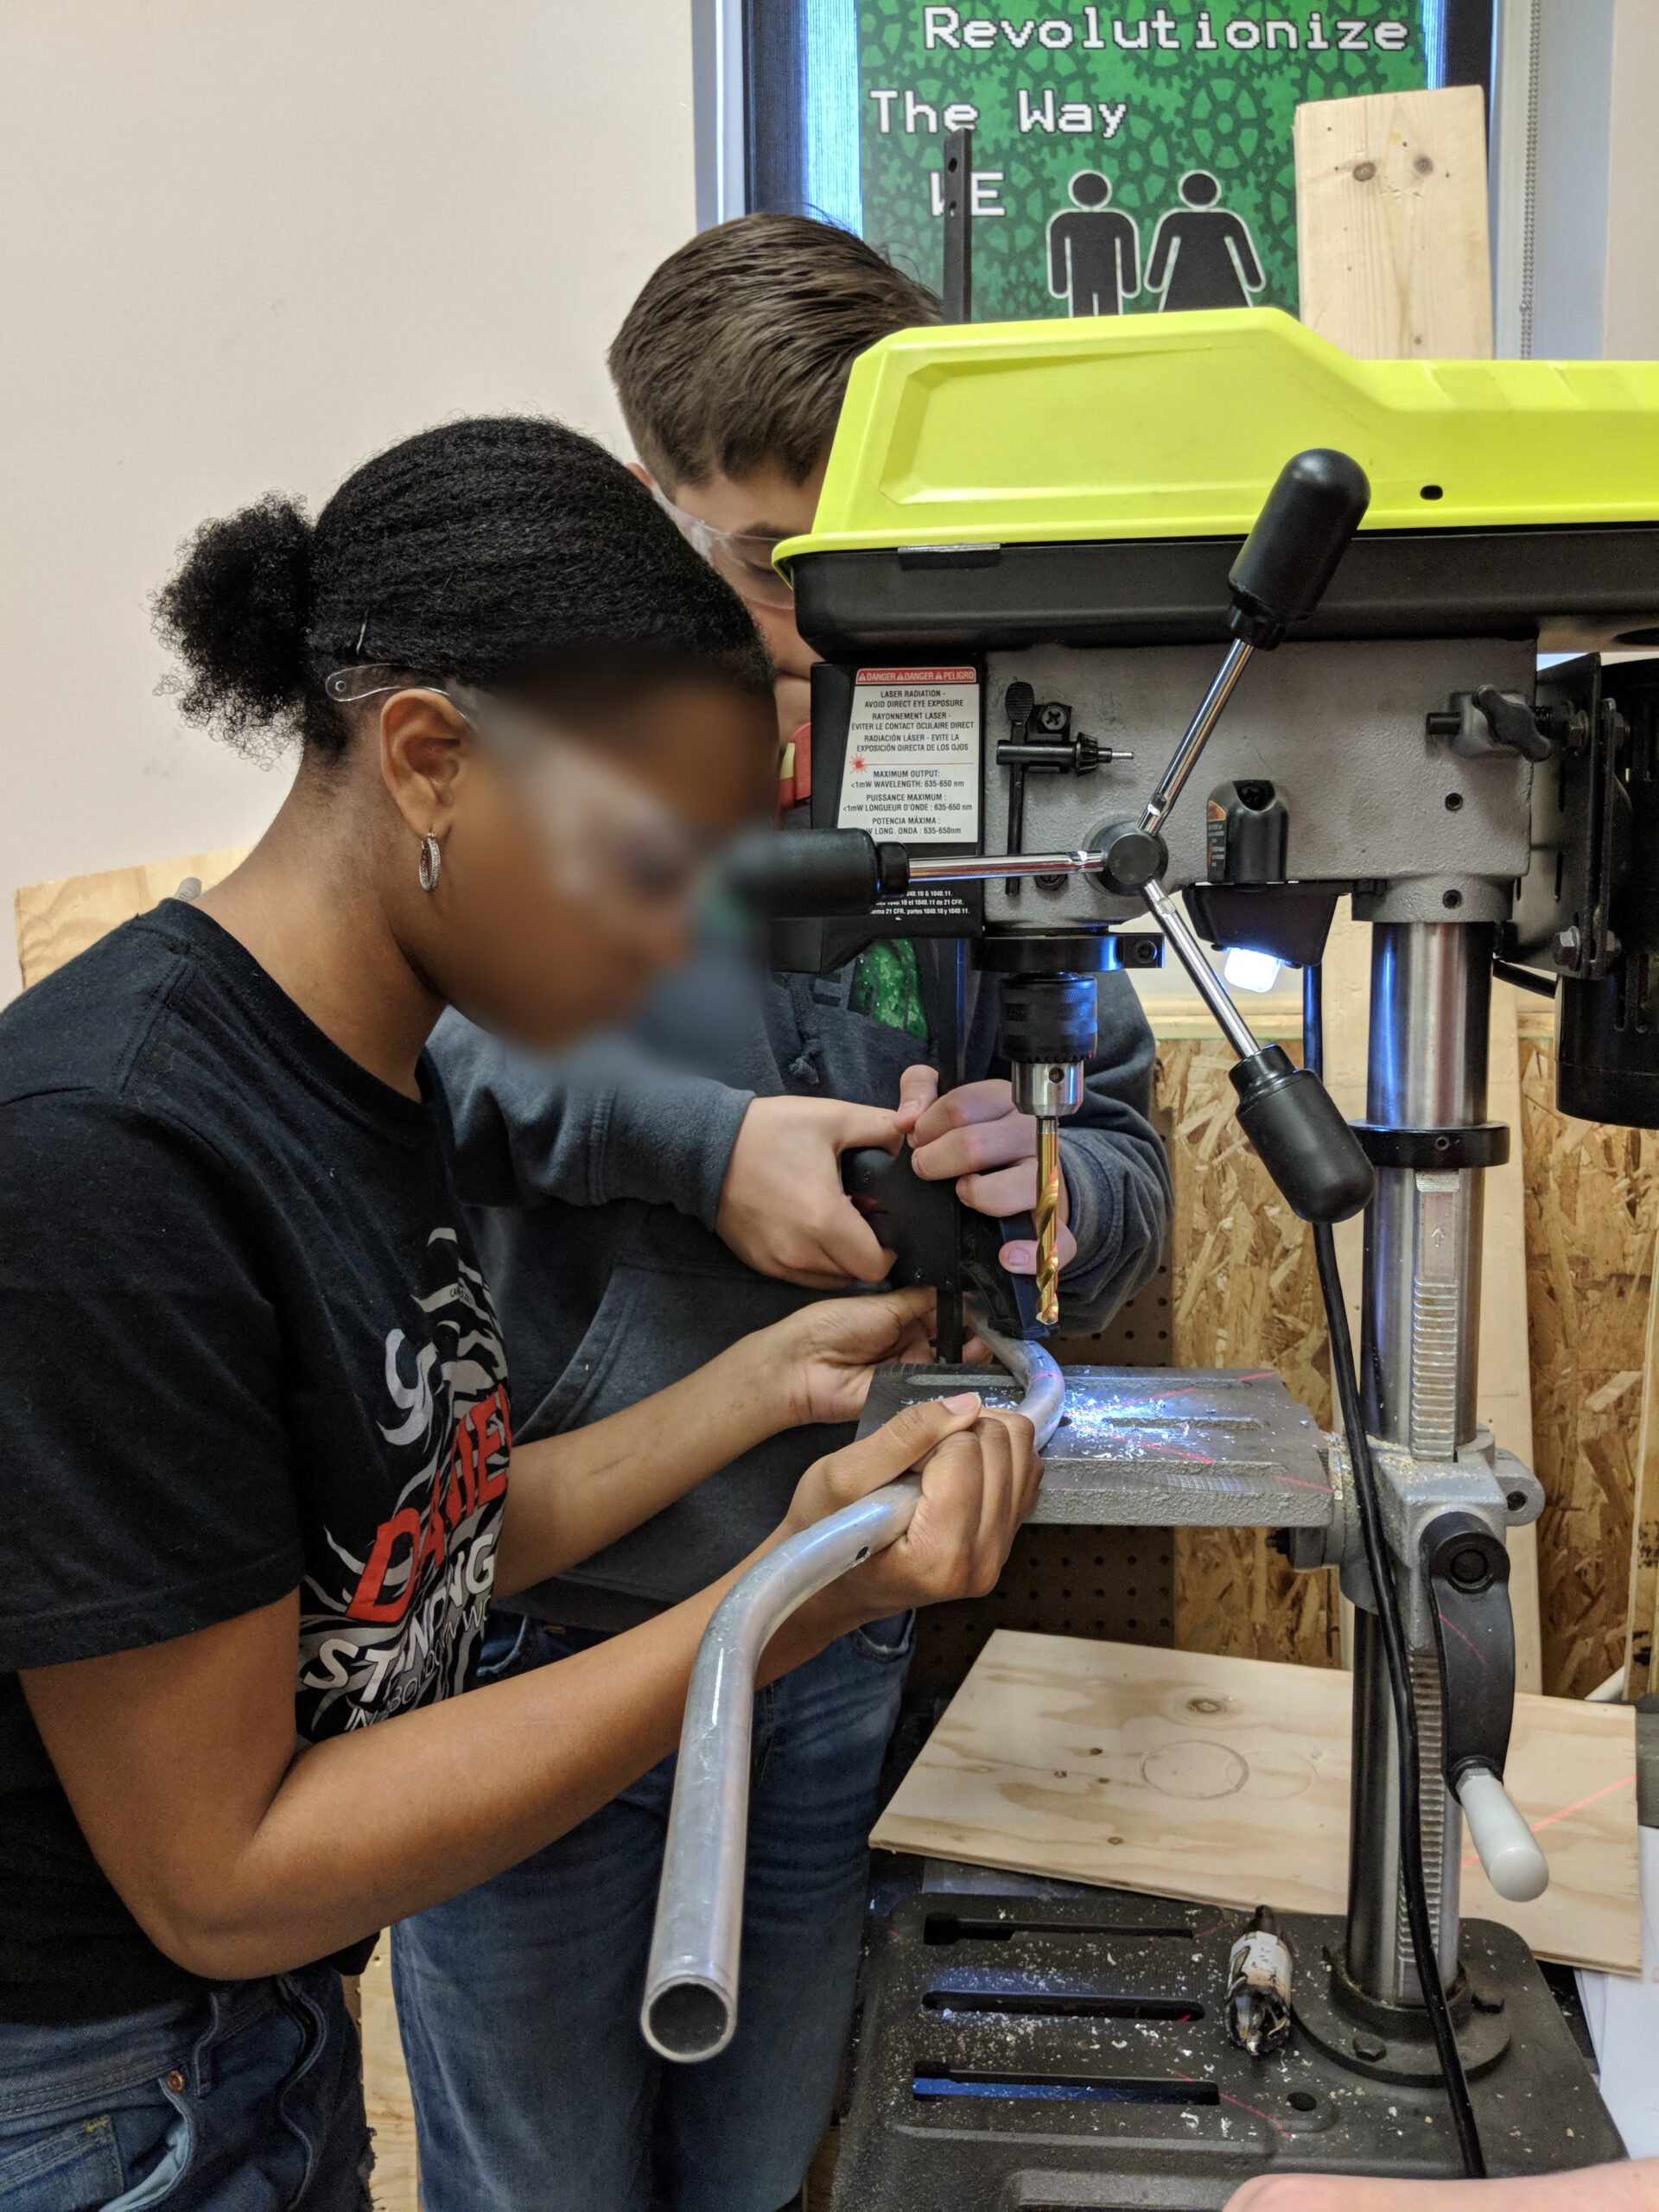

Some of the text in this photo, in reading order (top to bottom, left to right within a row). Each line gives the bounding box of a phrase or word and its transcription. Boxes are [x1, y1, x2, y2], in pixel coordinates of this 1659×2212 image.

[924, 6, 1409, 51] Revolutionize
[869, 89, 1127, 138] The Way
[866, 672, 896, 681] DANGER
[944, 671, 974, 680] PELIGRO
[857, 743, 896, 752] EXPOSICIÓN
